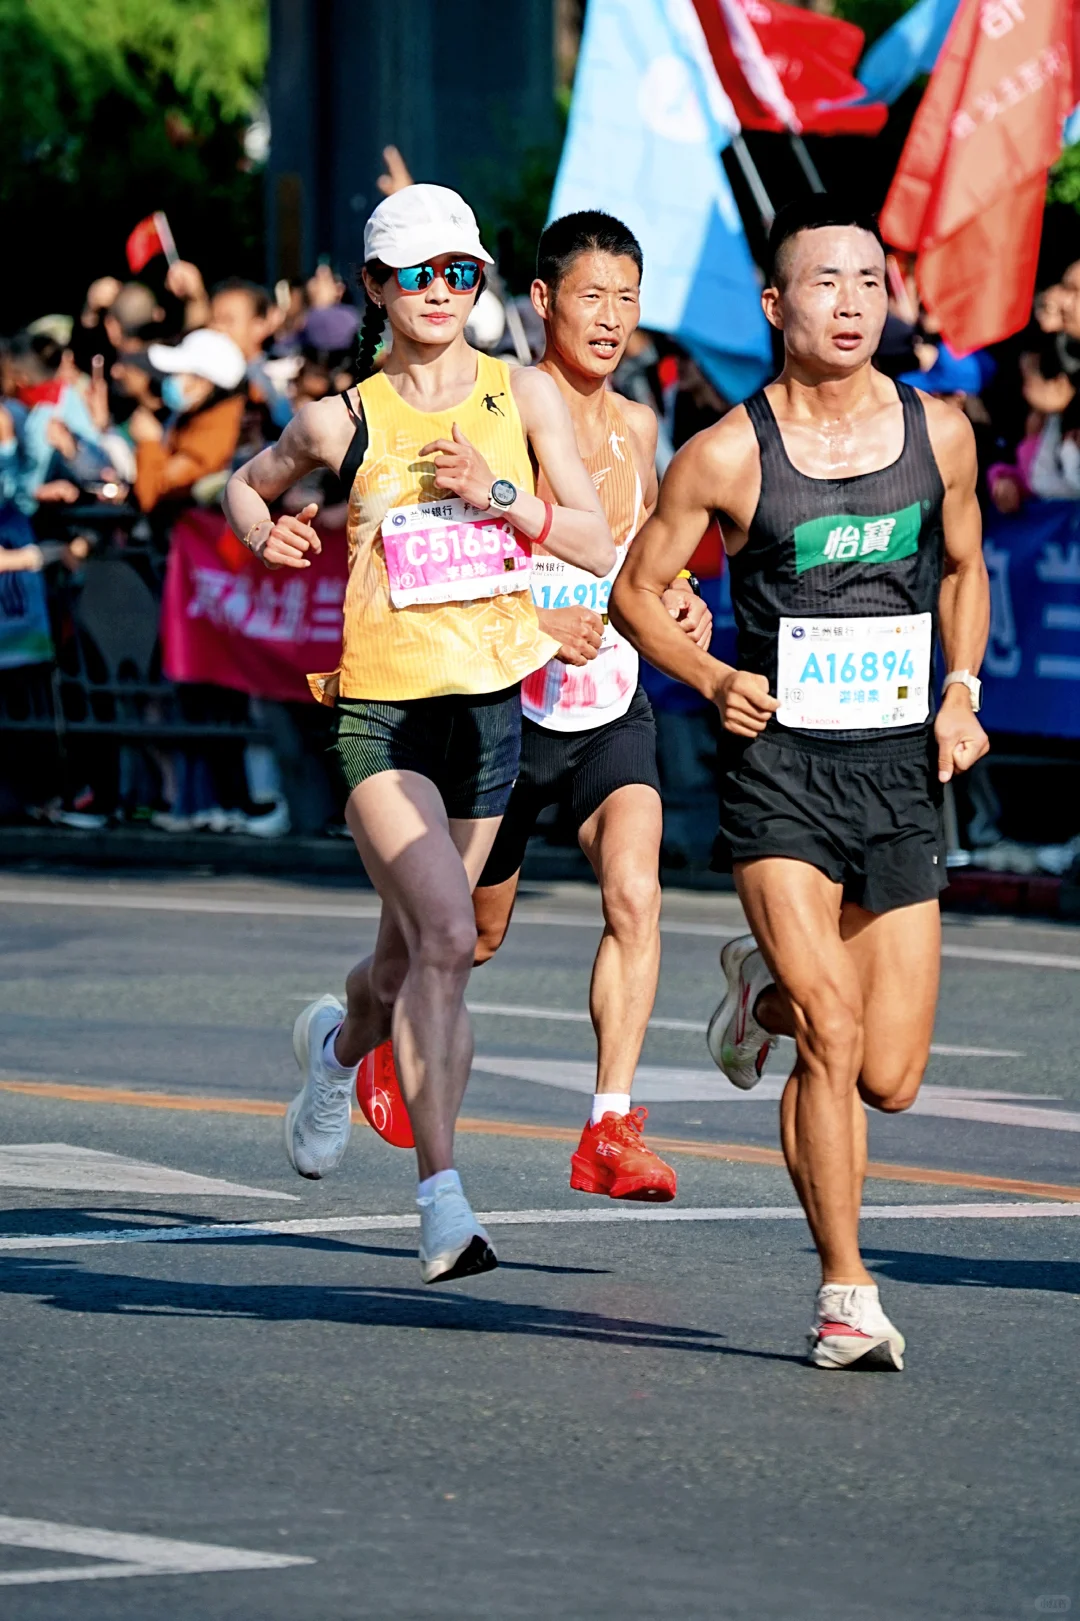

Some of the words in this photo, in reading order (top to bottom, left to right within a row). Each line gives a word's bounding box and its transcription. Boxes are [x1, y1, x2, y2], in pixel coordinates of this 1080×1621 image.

[410, 504, 453, 521] 兰州银行
[405, 522, 517, 567] C51653
[823, 517, 897, 560] 怡寶
[532, 561, 565, 572] 州银行
[530, 579, 613, 610] 14913
[810, 626, 855, 637] 兰州银行
[799, 649, 915, 684] A16894
